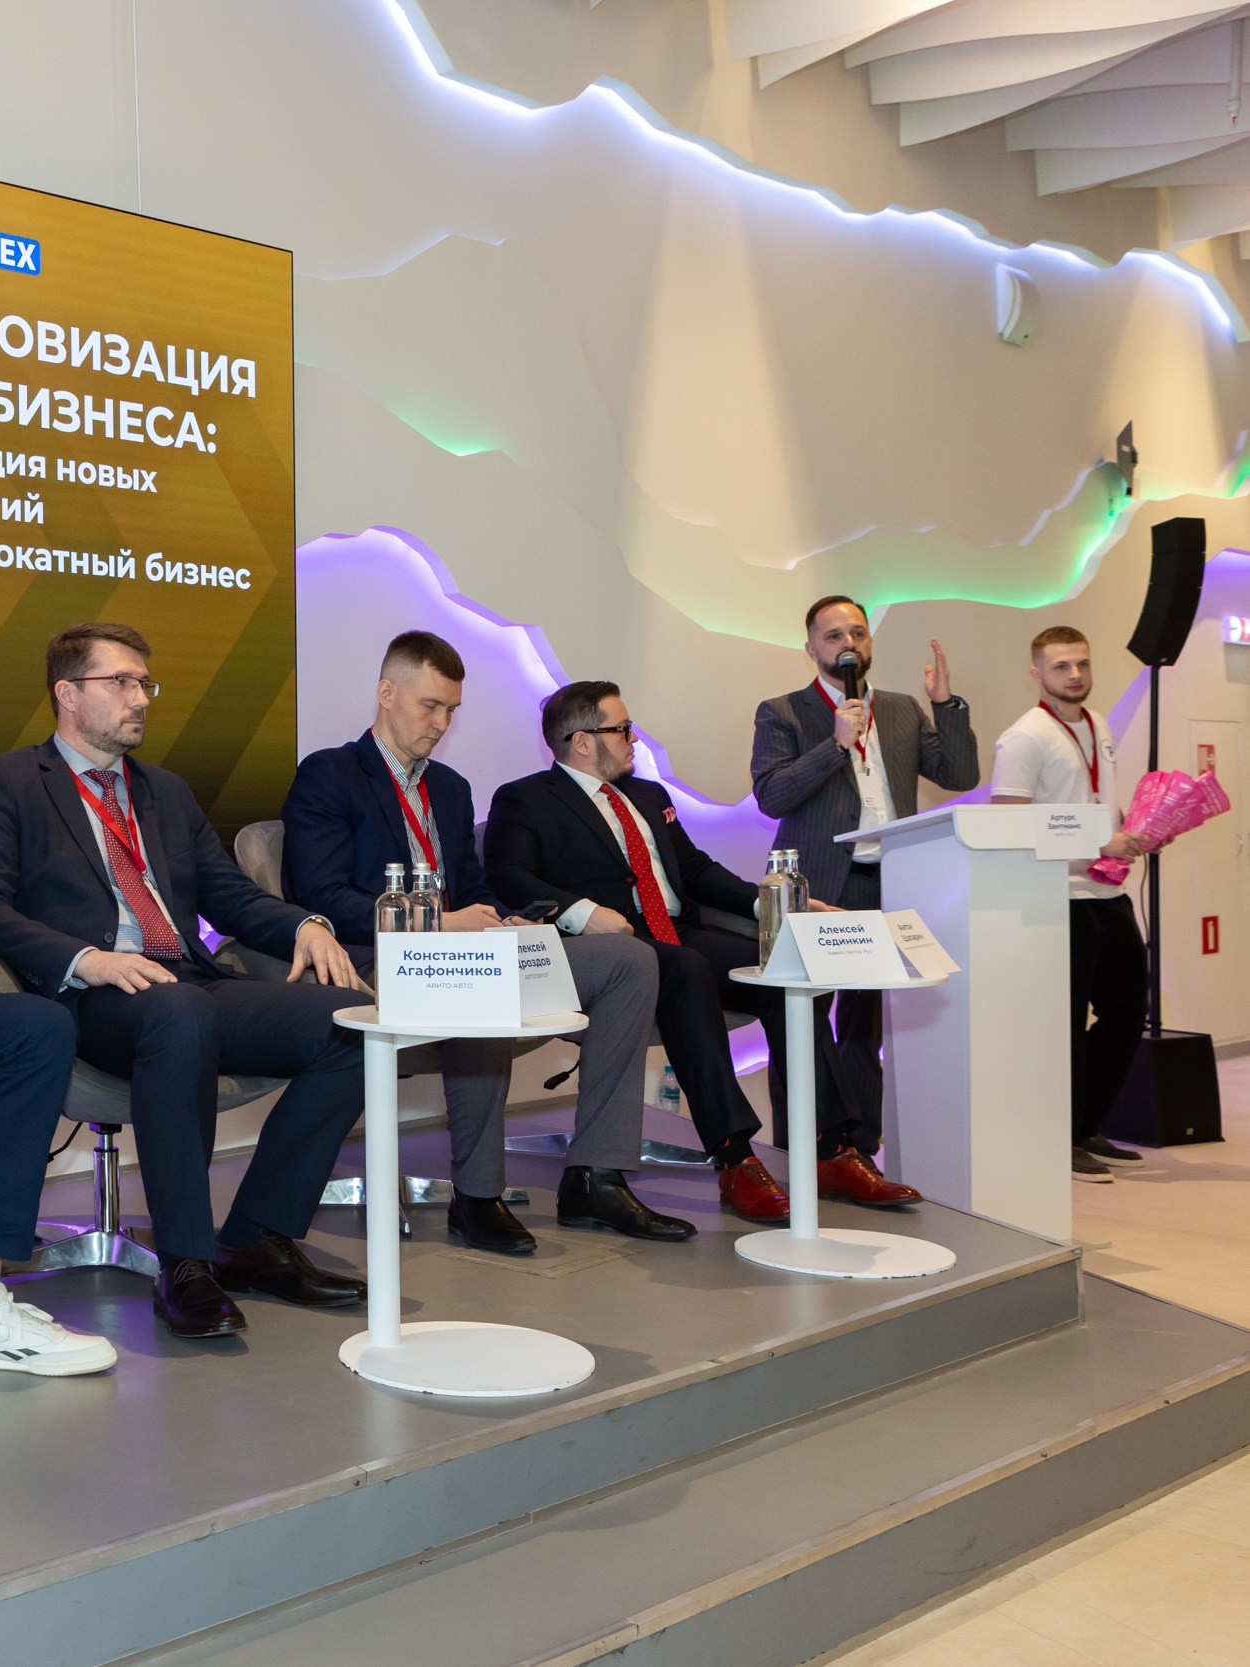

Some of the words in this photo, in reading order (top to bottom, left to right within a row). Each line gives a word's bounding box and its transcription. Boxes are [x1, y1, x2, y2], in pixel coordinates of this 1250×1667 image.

[56, 457, 158, 492] новых
[145, 552, 252, 590] бизнес
[818, 924, 865, 934] Алексей
[517, 941, 547, 953] лексей
[817, 937, 874, 946] Сединкин
[403, 950, 494, 961] Константин
[396, 965, 502, 979] Агафончиков
